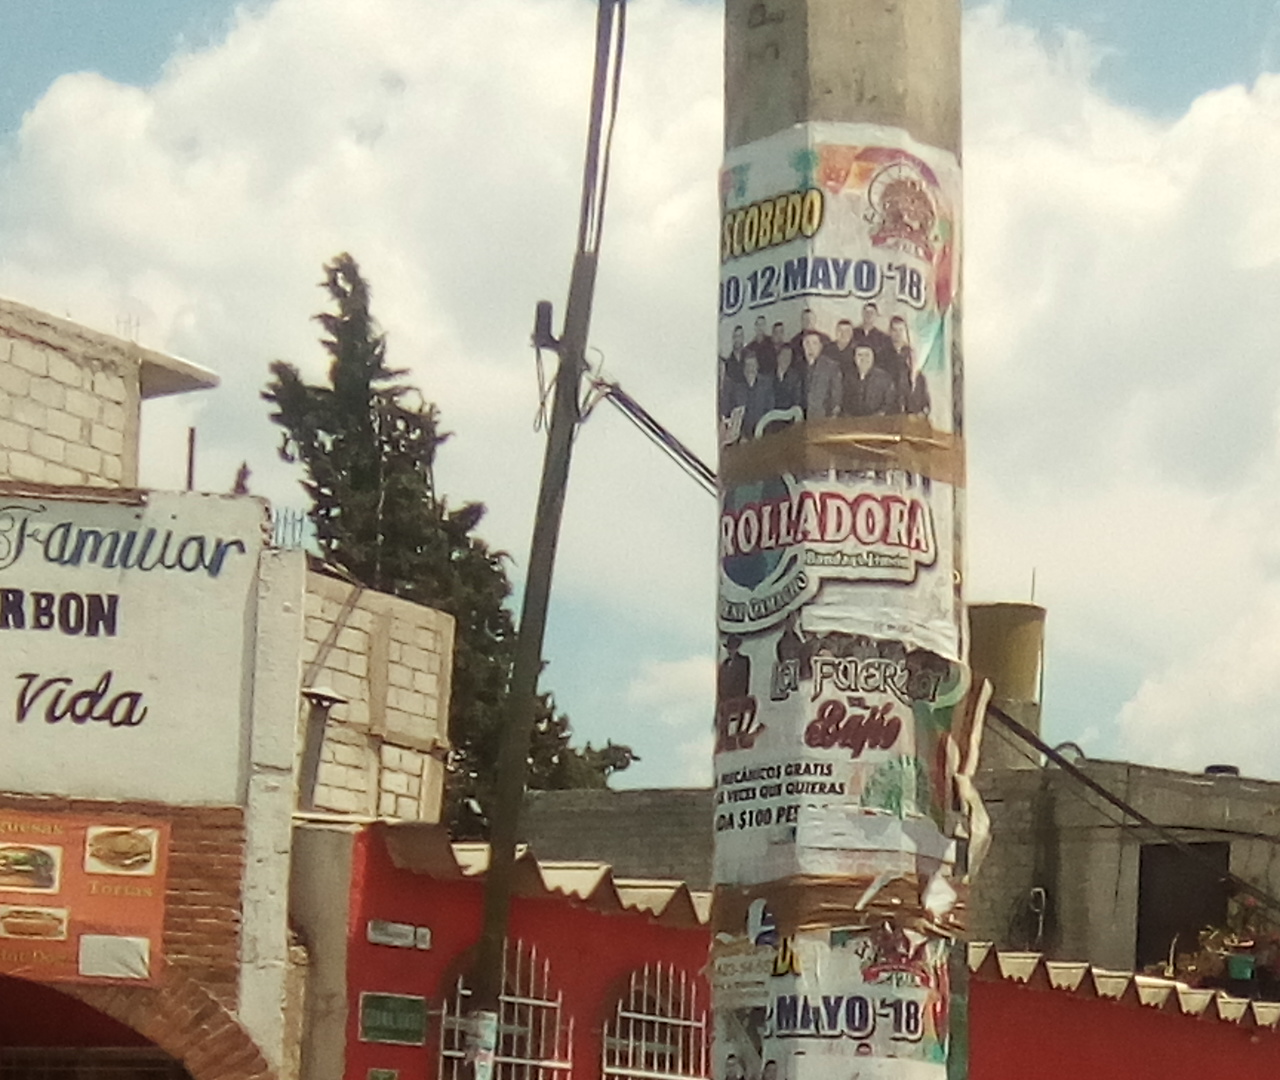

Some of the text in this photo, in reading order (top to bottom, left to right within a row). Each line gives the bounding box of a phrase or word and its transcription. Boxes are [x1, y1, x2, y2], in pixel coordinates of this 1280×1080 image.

[721, 275, 744, 316] O
[747, 265, 778, 304] 12
[782, 256, 880, 296] MAYO
[721, 493, 934, 557] ROLLADORA
[15, 670, 149, 728] Vida
[785, 762, 833, 777] GRATIS
[785, 781, 847, 796] QUIERAS
[739, 806, 773, 830] $100
[87, 880, 155, 897] Tortas
[775, 994, 873, 1034] MAYO
